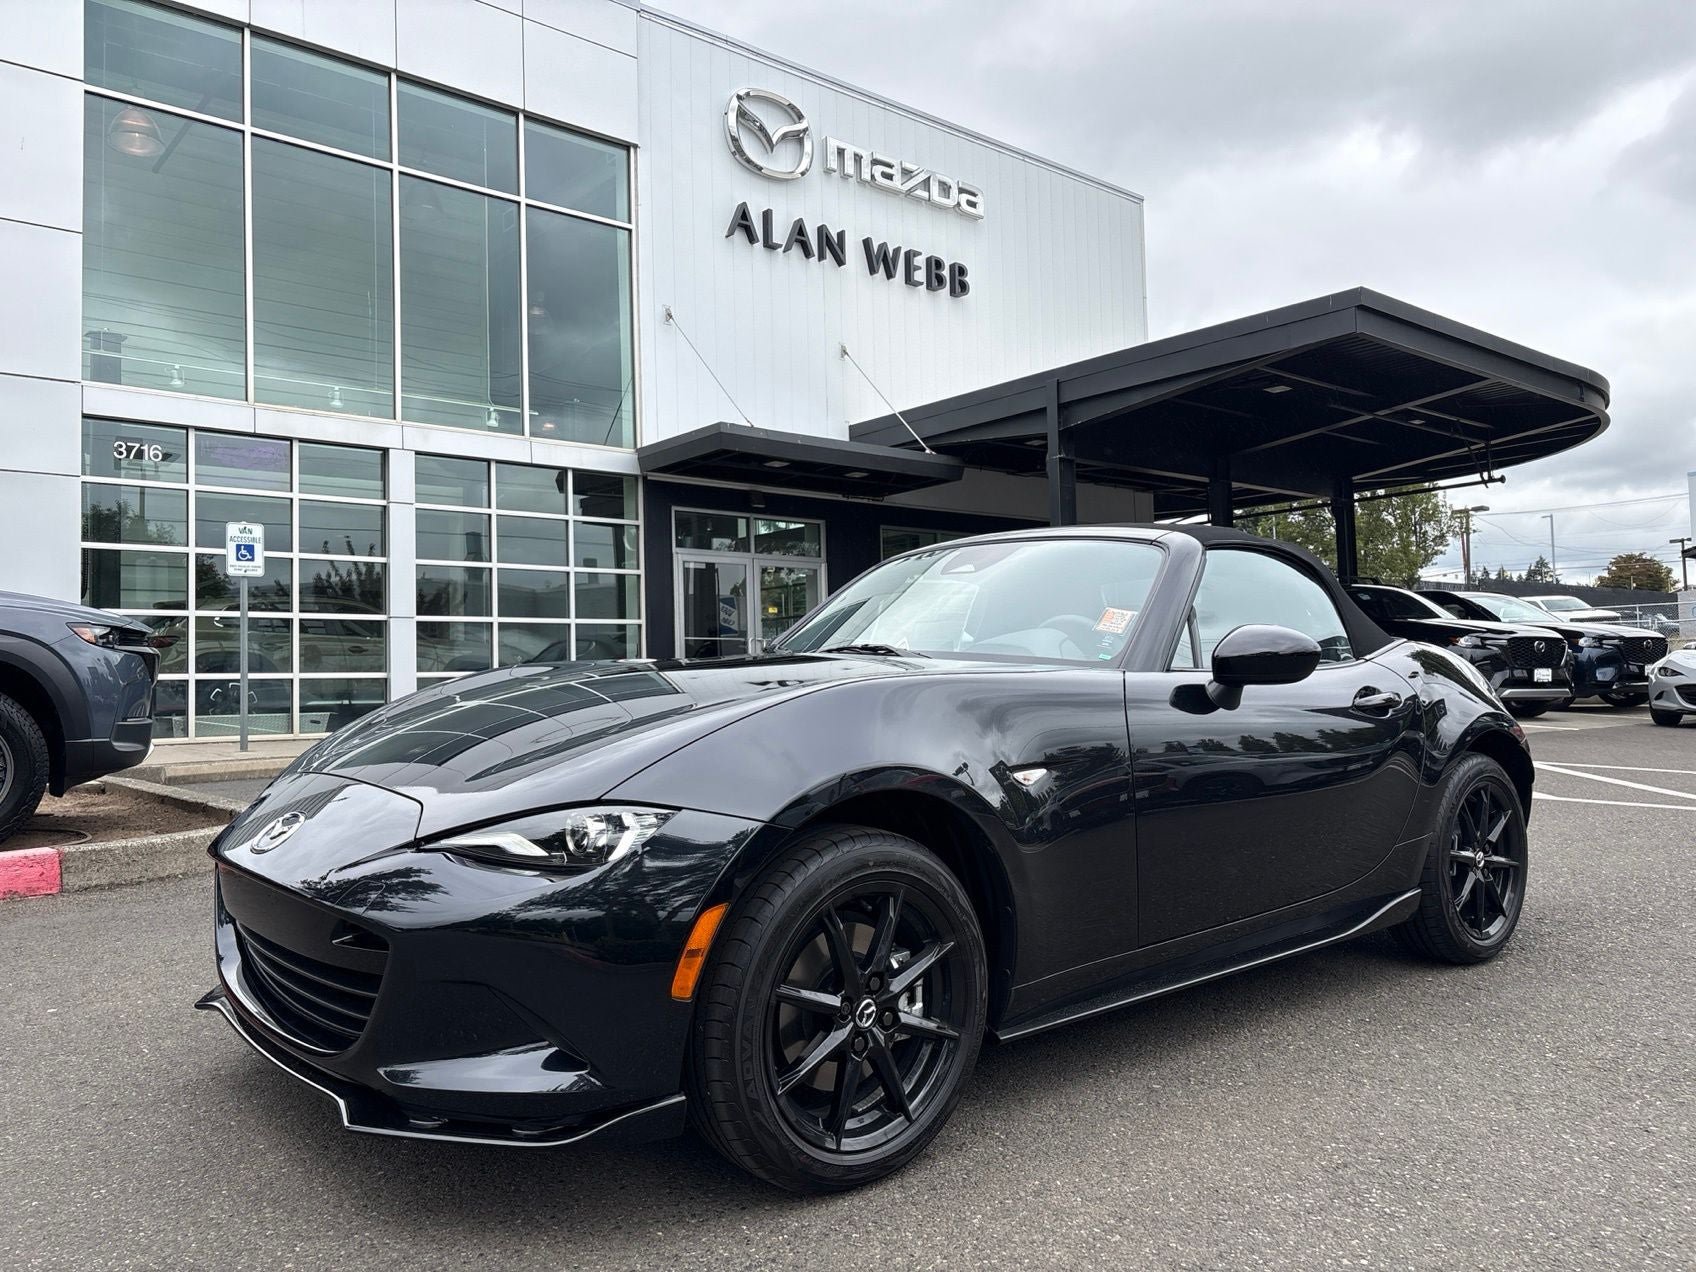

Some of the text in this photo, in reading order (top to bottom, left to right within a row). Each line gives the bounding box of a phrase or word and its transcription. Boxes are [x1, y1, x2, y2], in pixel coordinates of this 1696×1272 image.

[725, 201, 970, 298] ALAN WEBB
[112, 441, 163, 462] 3716
[238, 526, 254, 535] VAN
[229, 535, 262, 544] ACCESSIBLE
